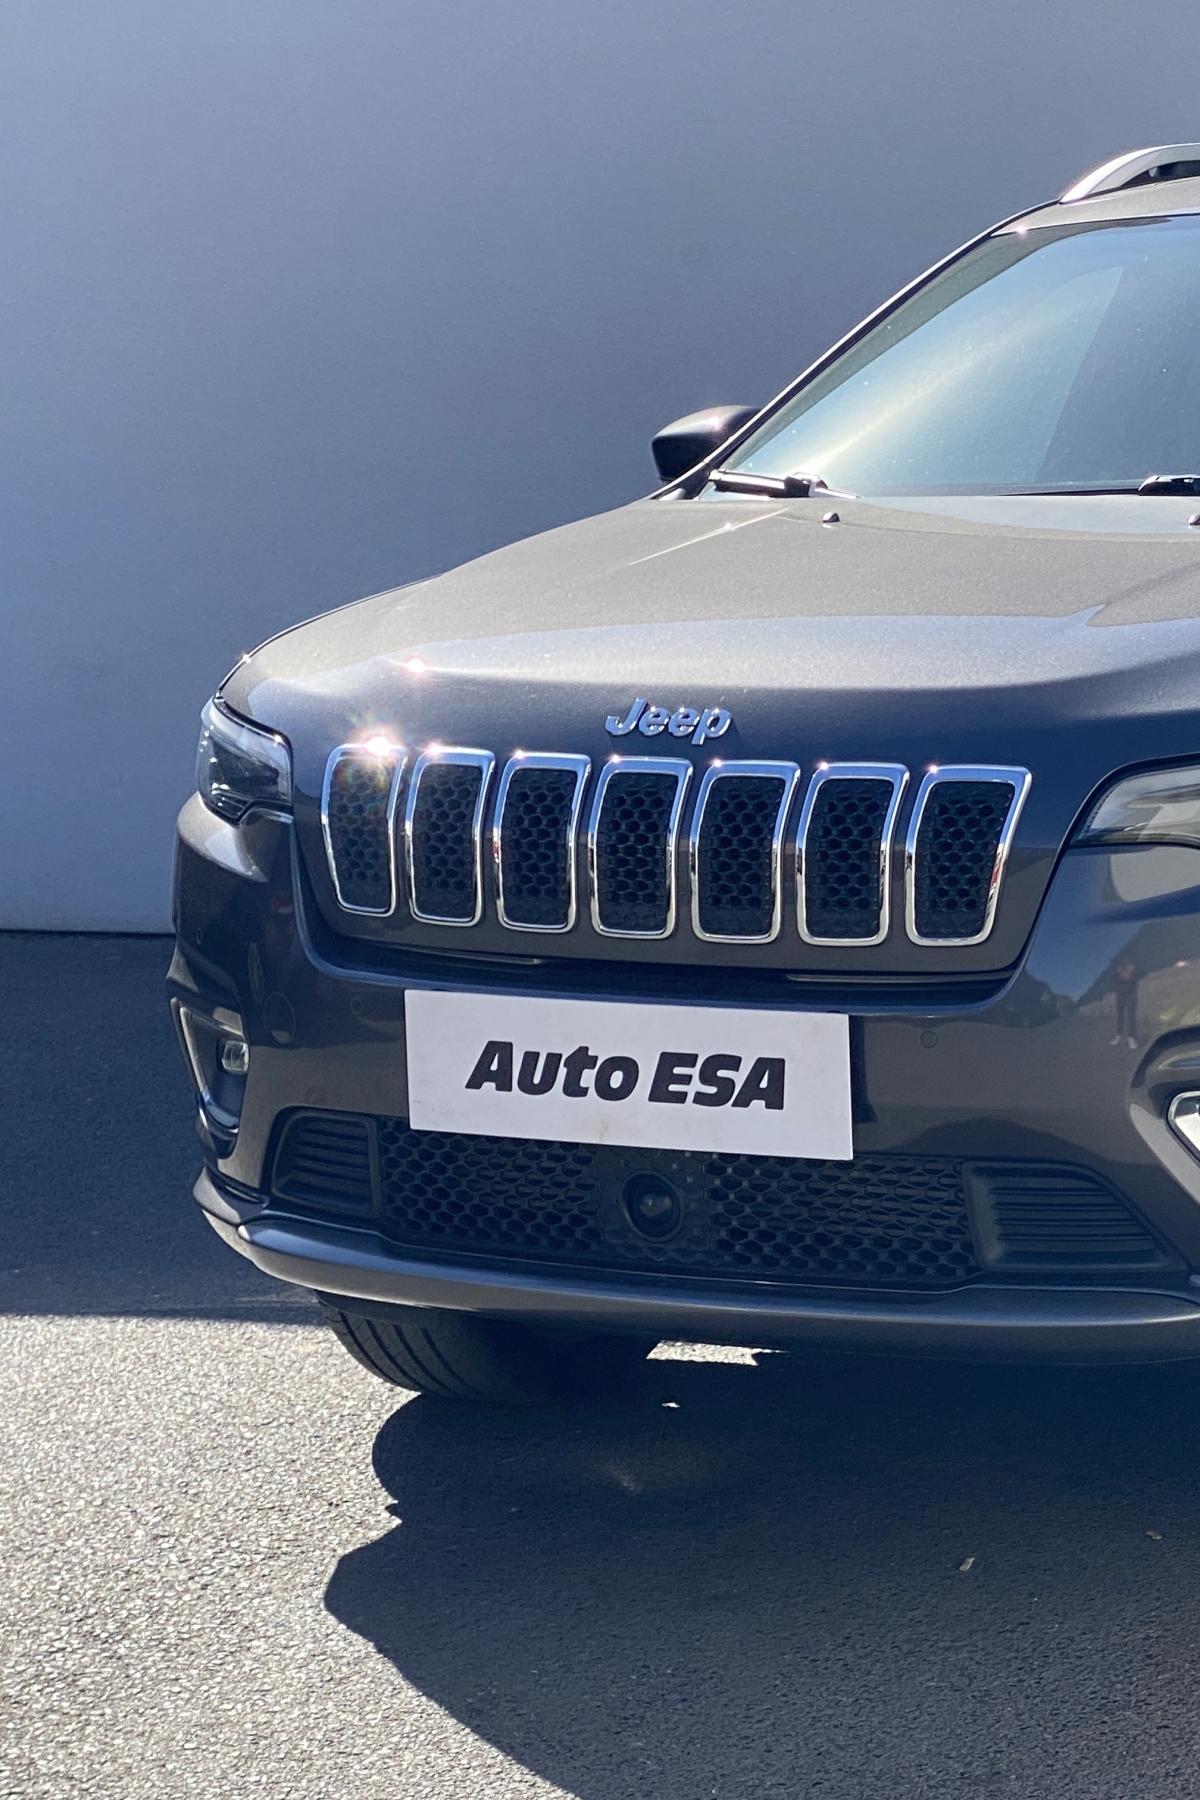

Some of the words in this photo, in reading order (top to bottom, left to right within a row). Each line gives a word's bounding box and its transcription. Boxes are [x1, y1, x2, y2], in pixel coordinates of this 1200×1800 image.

[605, 698, 733, 746] Jeep
[464, 1039, 640, 1102] Auto
[647, 1050, 786, 1111] ESA
